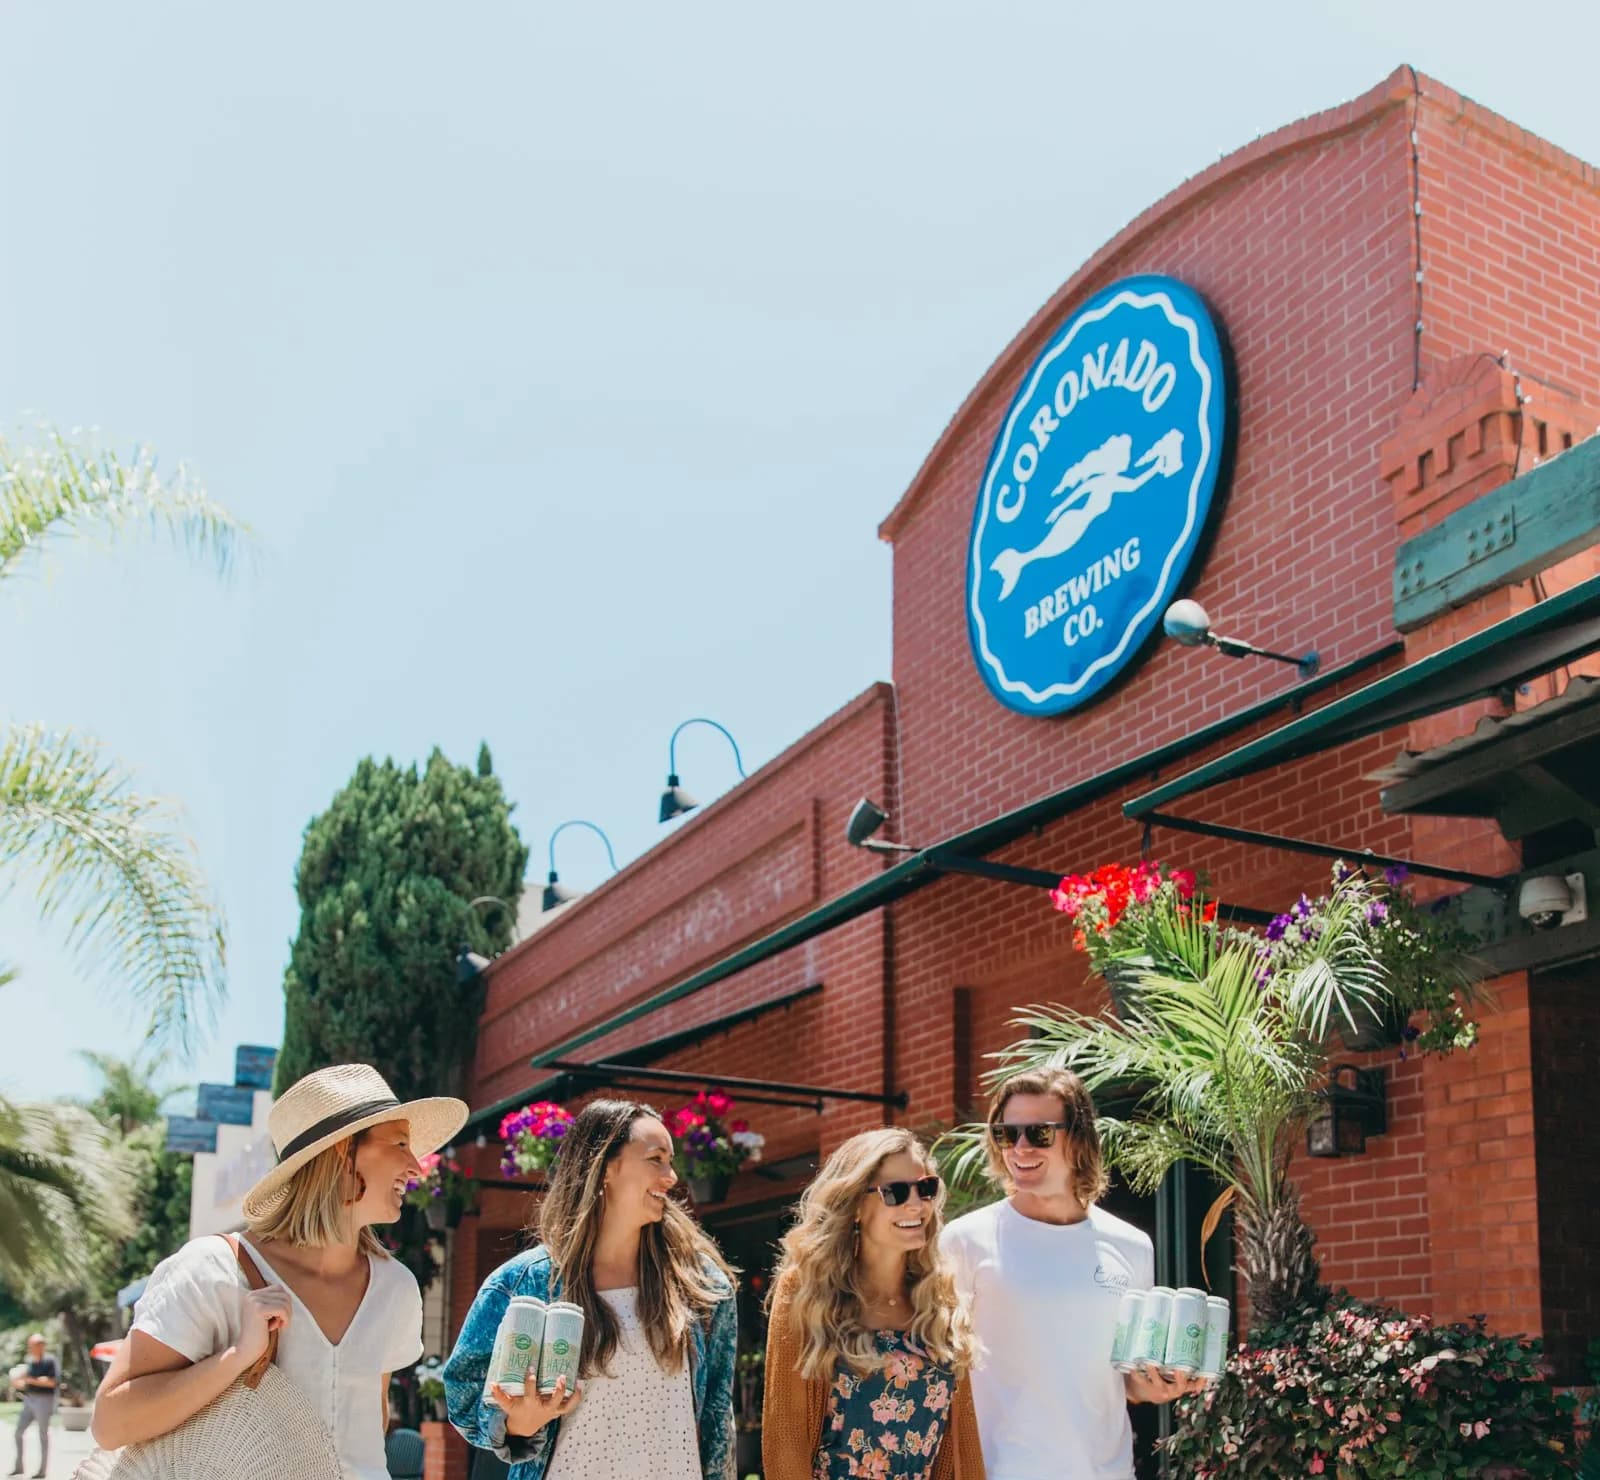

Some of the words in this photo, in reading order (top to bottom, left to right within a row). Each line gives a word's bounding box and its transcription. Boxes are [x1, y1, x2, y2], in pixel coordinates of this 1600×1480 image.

[996, 338, 1175, 523] CORONADO
[1024, 537, 1141, 638] BREWING
[1063, 604, 1103, 648] CO.
